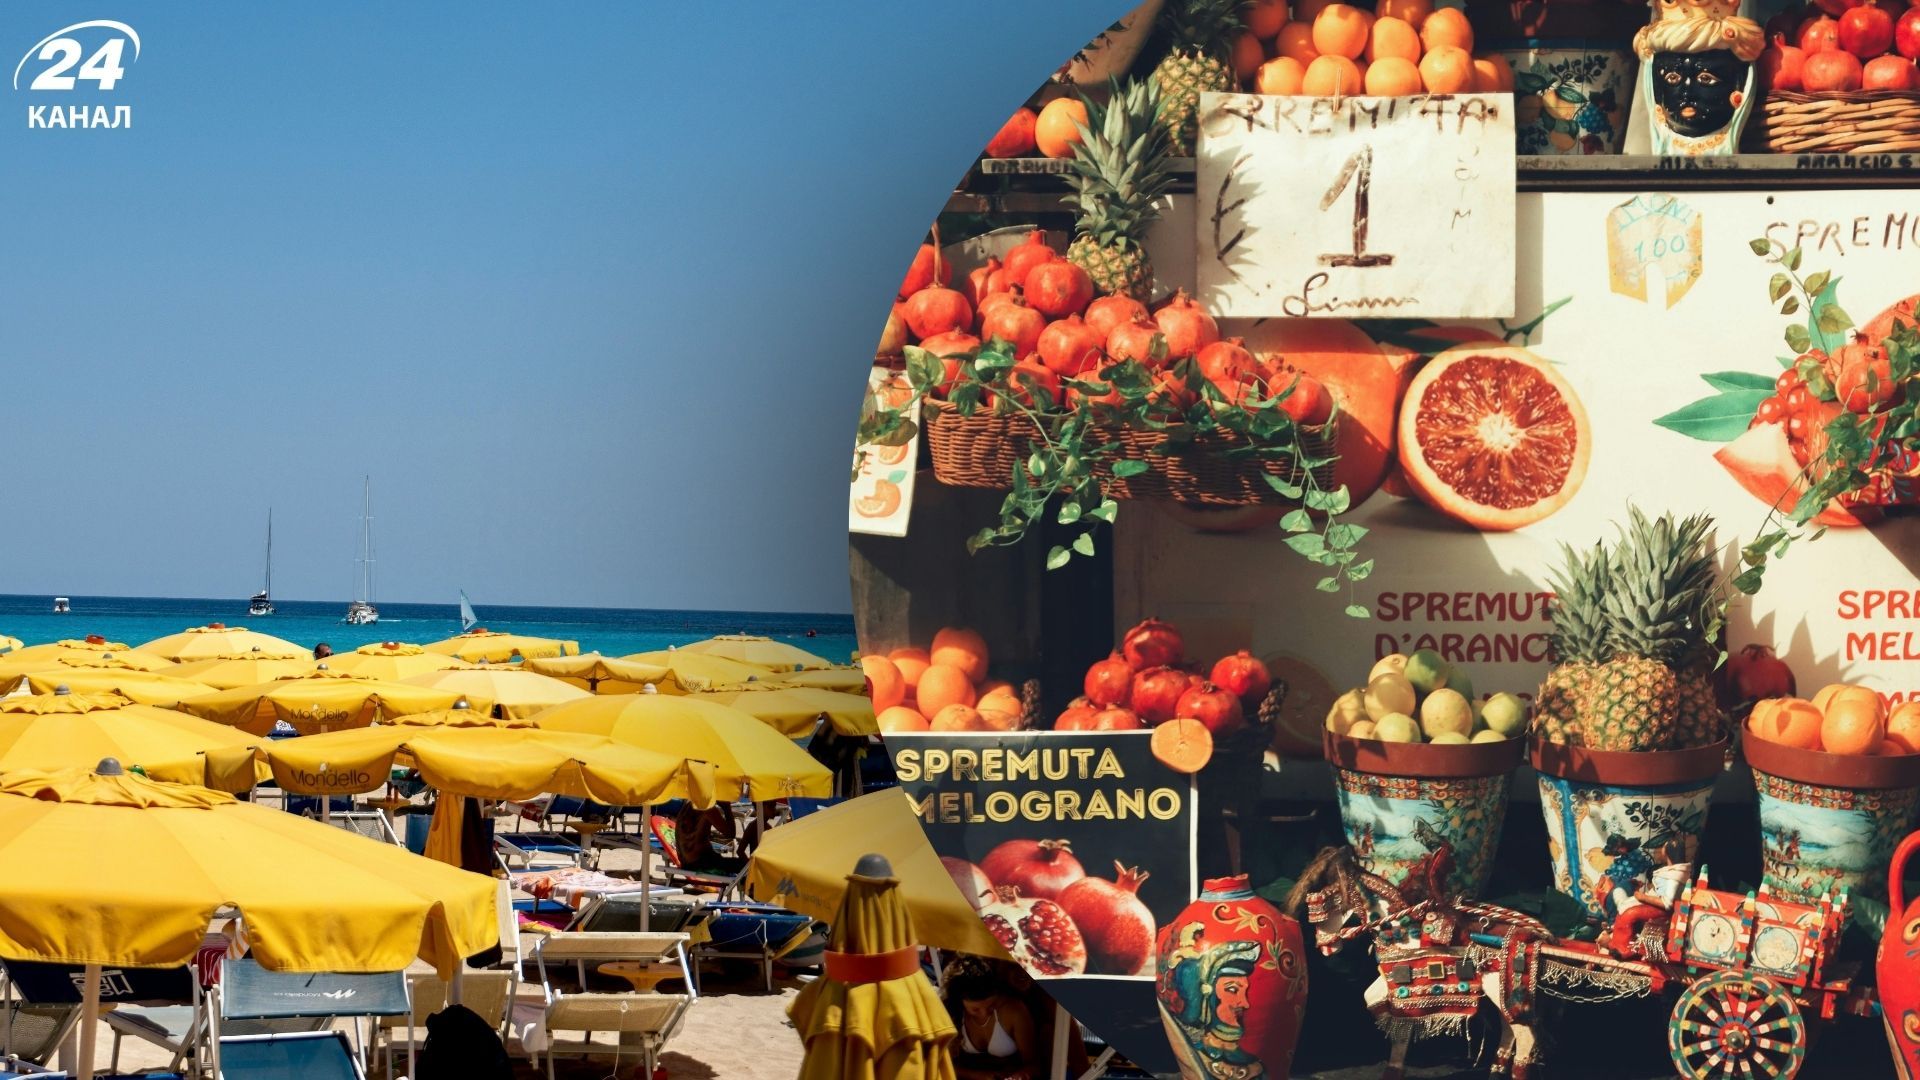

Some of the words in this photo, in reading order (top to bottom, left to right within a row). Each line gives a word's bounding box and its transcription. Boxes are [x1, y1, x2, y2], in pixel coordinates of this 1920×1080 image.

[1318, 143, 1397, 268] 1
[290, 768, 371, 787] Mondello
[895, 747, 1125, 783] SPREMUTA
